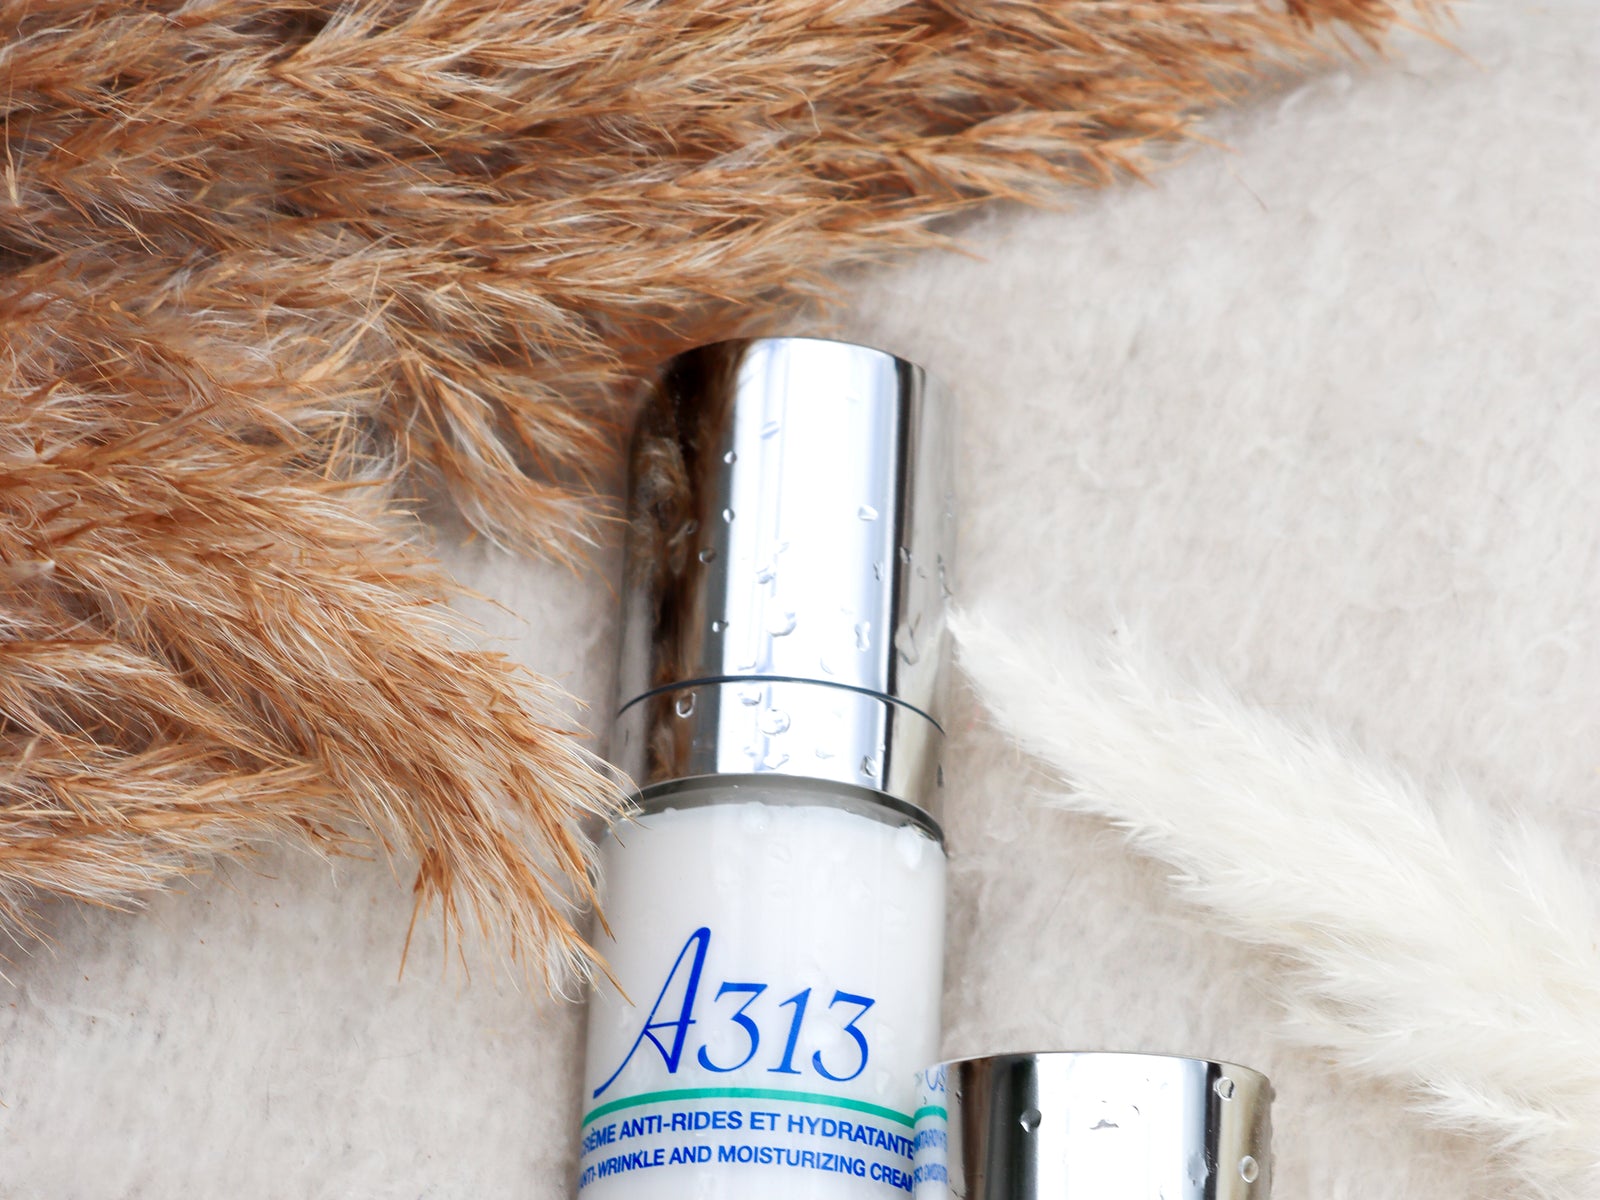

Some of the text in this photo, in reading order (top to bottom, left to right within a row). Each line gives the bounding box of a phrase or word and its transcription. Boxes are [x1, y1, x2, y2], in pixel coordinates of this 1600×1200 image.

[593, 926, 877, 1099] A313
[581, 1126, 617, 1158] RÈME
[618, 1110, 743, 1141] ANTI-RIDES
[749, 1111, 777, 1132] ET
[786, 1115, 914, 1161] HYDRATANTE
[668, 1145, 713, 1166] AND
[717, 1144, 866, 1179] MOISTURIZING
